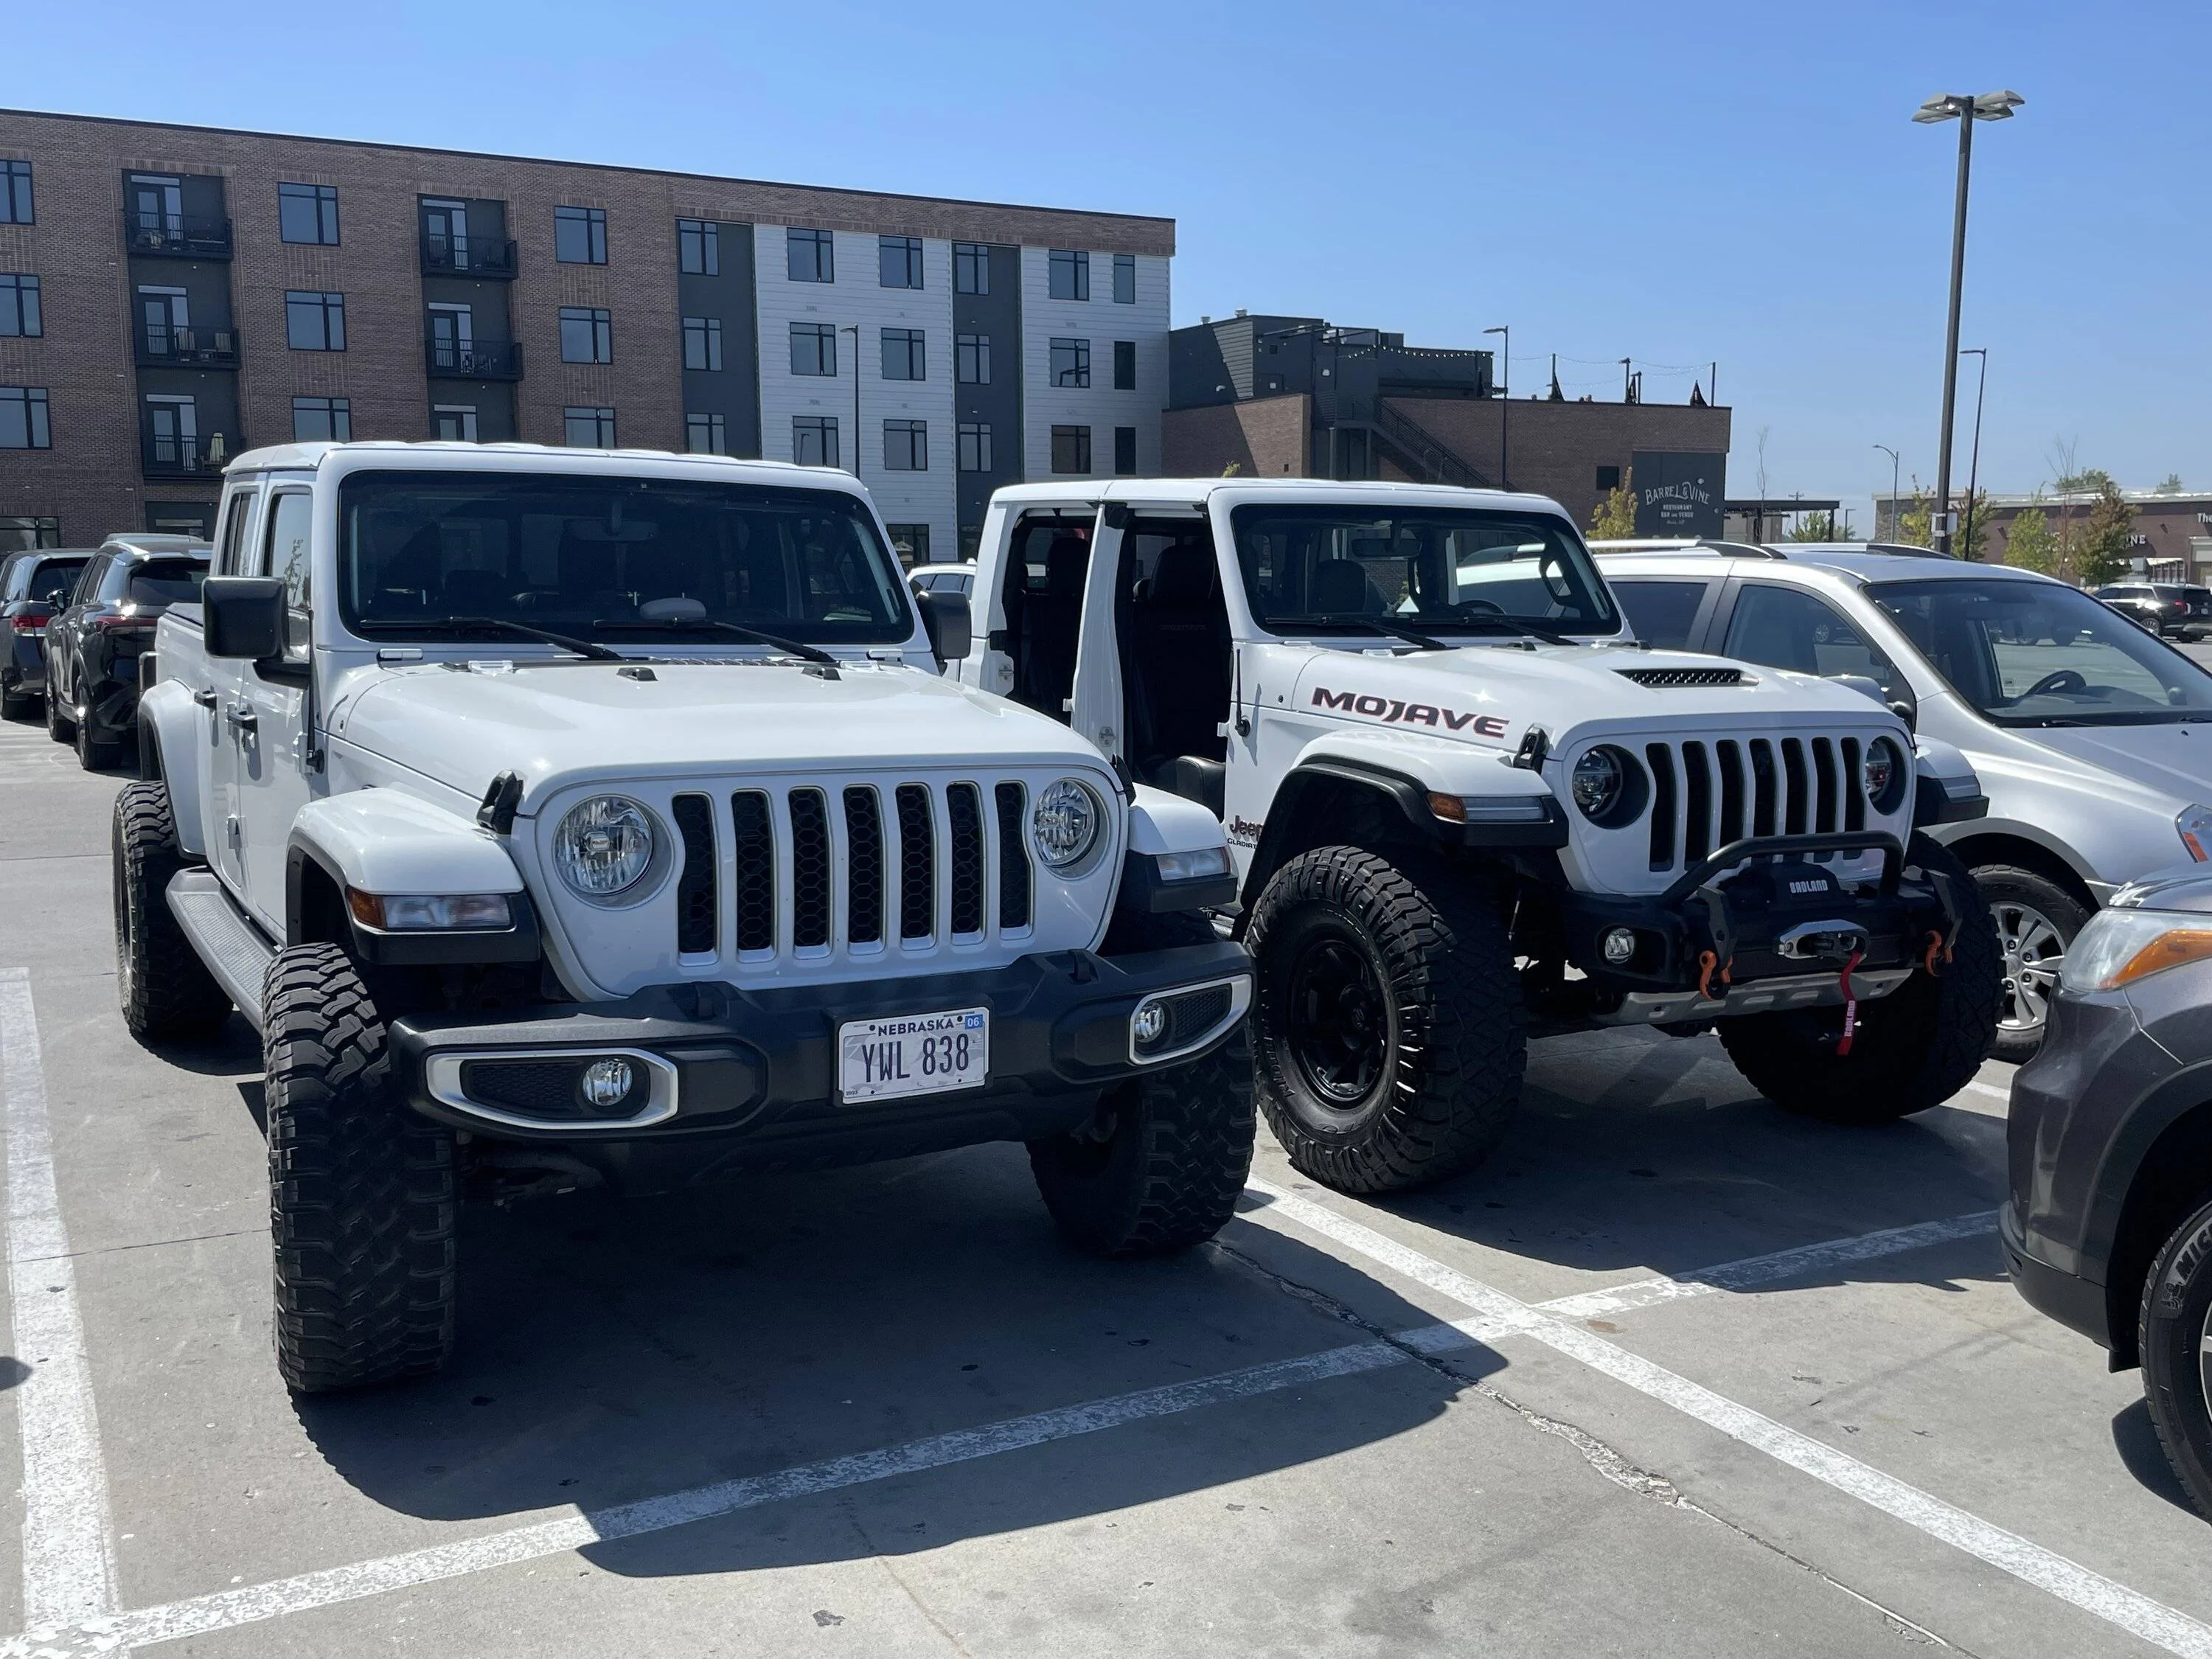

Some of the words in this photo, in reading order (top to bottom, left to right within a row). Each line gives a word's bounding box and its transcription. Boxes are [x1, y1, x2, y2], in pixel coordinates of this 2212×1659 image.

[1645, 484, 1688, 506] BARREL
[1682, 481, 1710, 505] VINE
[1310, 686, 1510, 740] MOJAVE
[1227, 838, 1257, 849] GLADIAT
[1790, 879, 1829, 894] BADLAND
[877, 1018, 954, 1037] NEBRASKA
[967, 1014, 980, 1027] 06
[1844, 1000, 1856, 1037] BADLAND
[861, 1040, 911, 1083] YWL
[922, 1033, 970, 1076] 838
